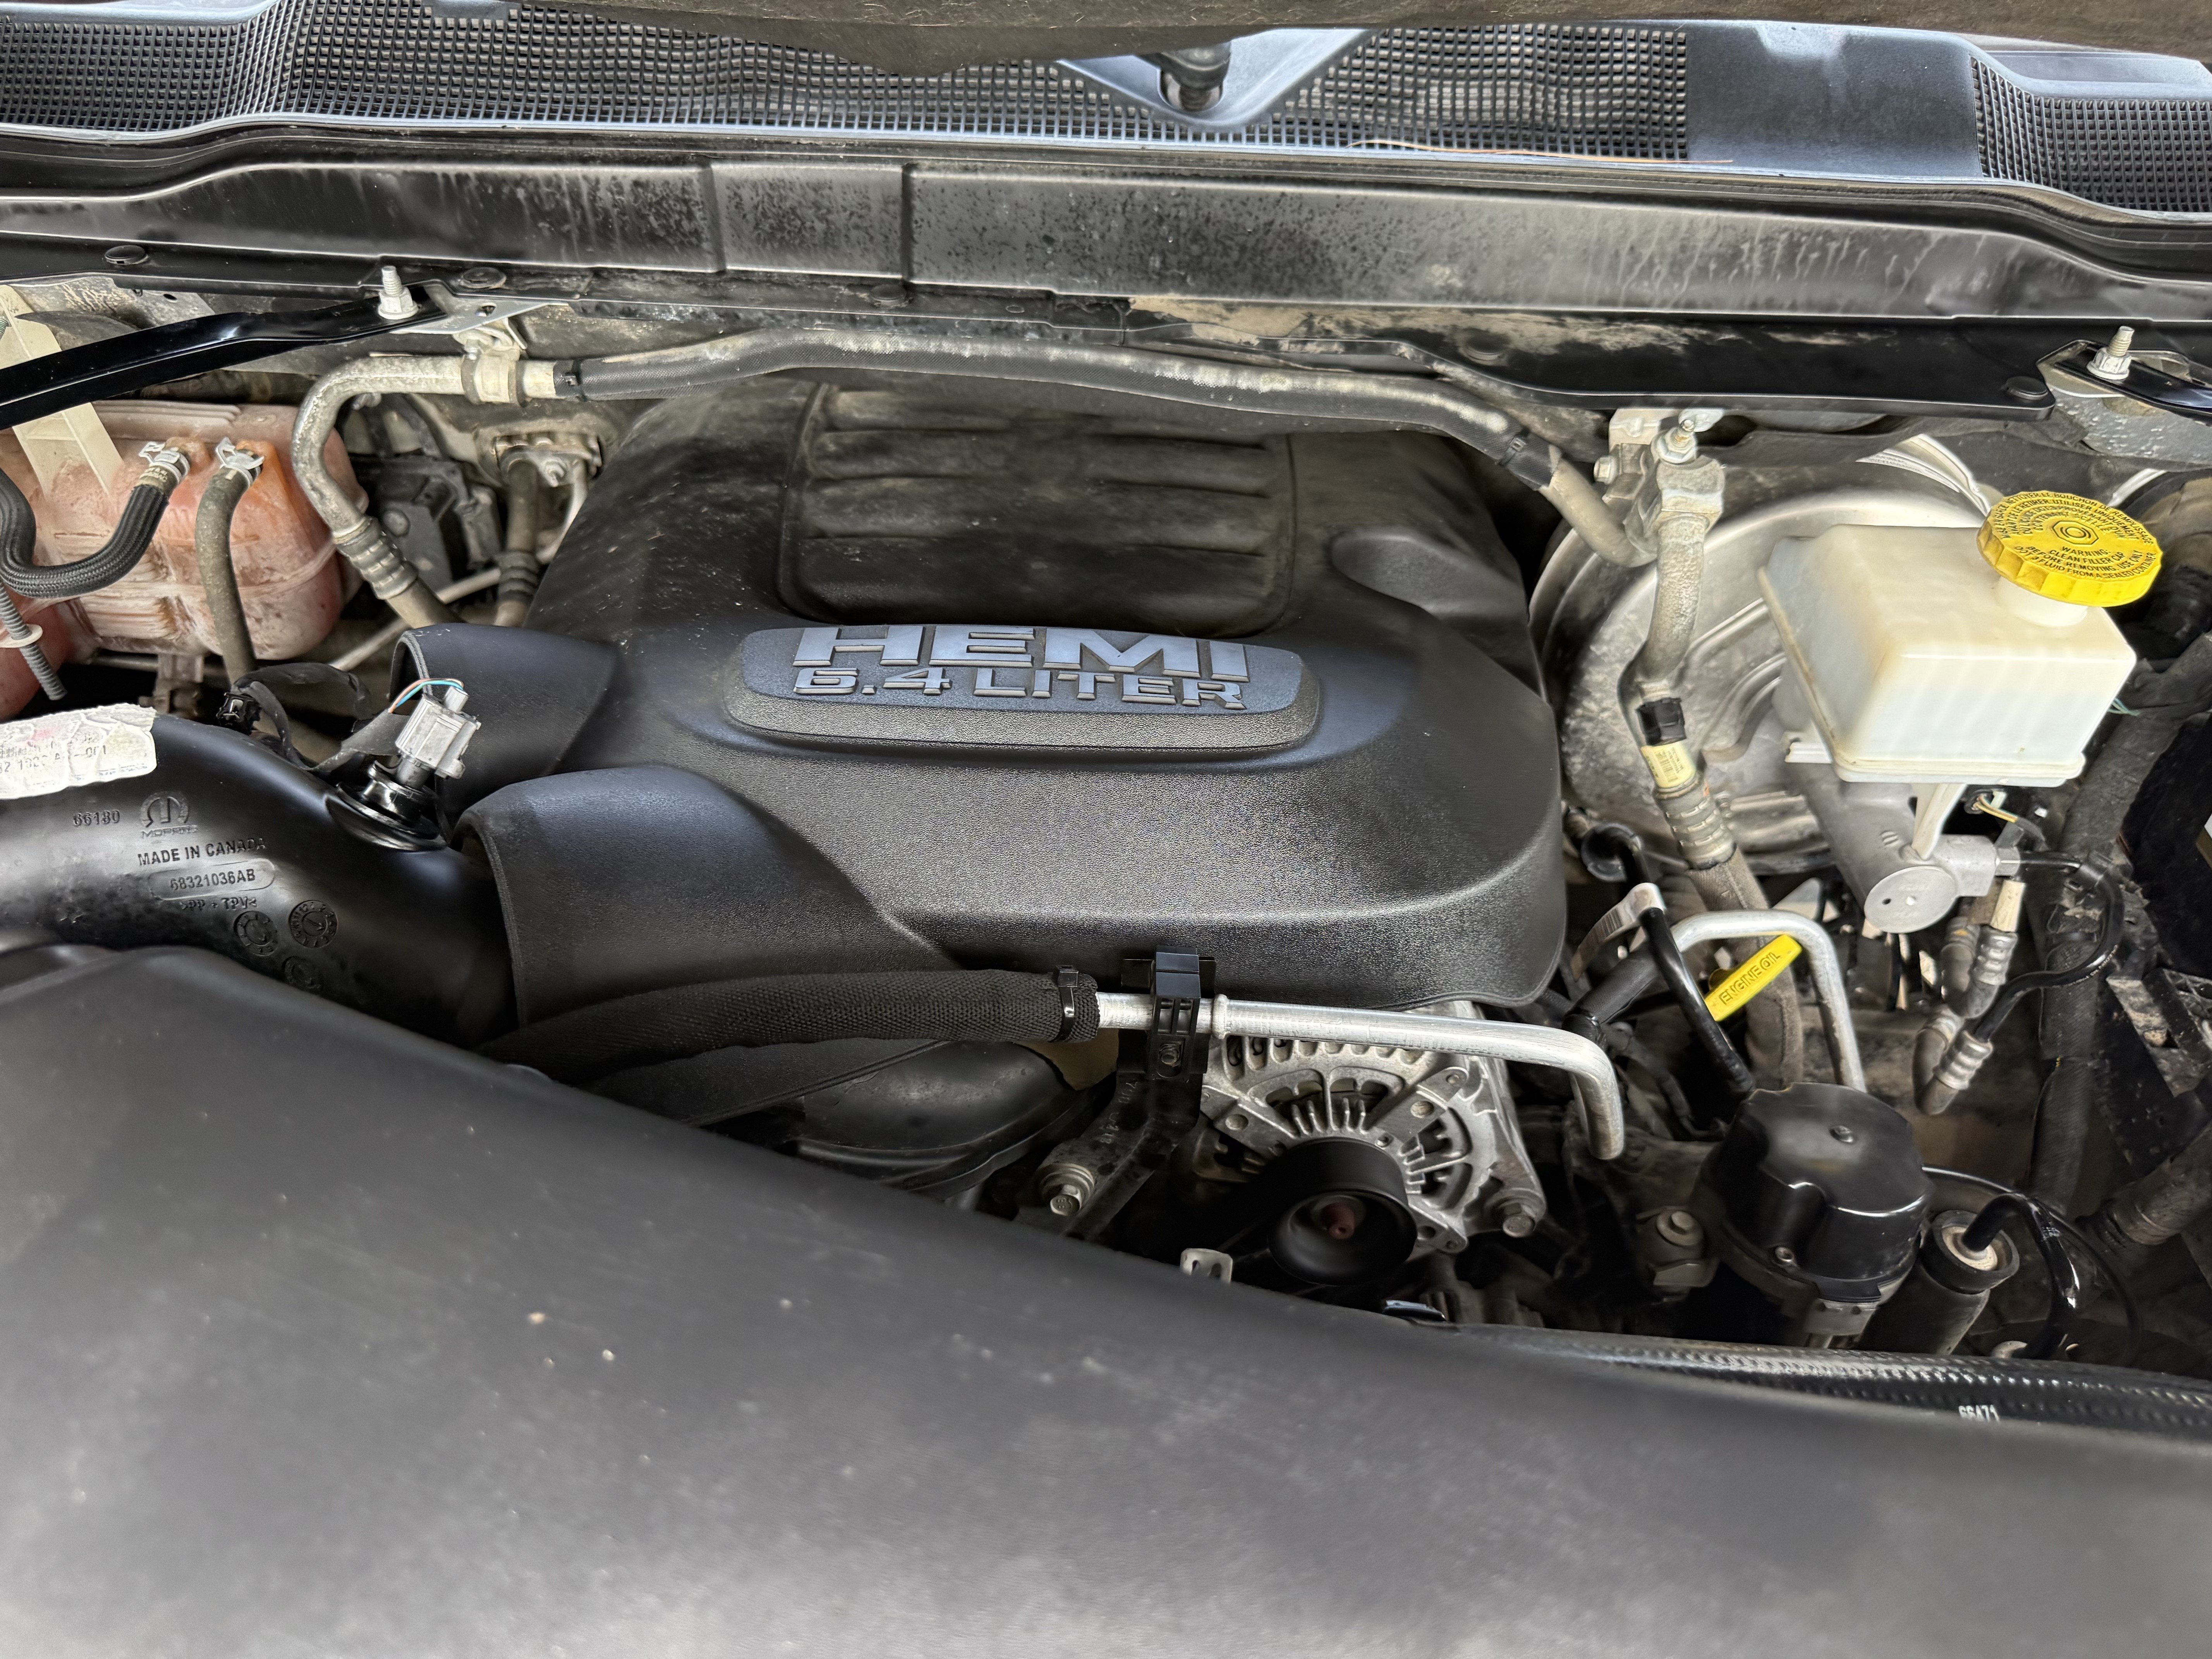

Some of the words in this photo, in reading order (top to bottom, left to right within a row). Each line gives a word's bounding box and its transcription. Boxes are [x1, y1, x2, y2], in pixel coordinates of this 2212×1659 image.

[2052, 500, 2092, 511] UTILISER
[2094, 509, 2140, 540] UNIQUEMENT
[2054, 493, 2097, 506] BOUCHON
[2112, 510, 2154, 545] REMPLISSAGE
[2014, 546, 2034, 556] DOT
[2039, 559, 2065, 571] FLUID
[2067, 568, 2094, 577] FROM
[2103, 570, 2135, 579] SEALED
[2132, 552, 2156, 574] CONTAINER
[2026, 546, 2063, 565] BEFORE
[2066, 562, 2119, 572] REMOVING.
[2117, 560, 2134, 569] USE
[2129, 550, 2143, 562] ONLY
[2049, 550, 2080, 562] CLEAN
[2111, 551, 2125, 561] CAP
[2062, 546, 2111, 556] WARNING:
[792, 625, 1249, 682] HEMI
[793, 667, 952, 696] 6.4
[973, 668, 1248, 710] LITER
[73, 809, 120, 828] 66180
[137, 848, 180, 866] MADE
[185, 845, 200, 859] IN
[205, 838, 266, 857] CANADA
[170, 869, 256, 891] 68321036AB
[1719, 965, 1762, 1005] ENGINE
[1760, 952, 1781, 971] OIL
